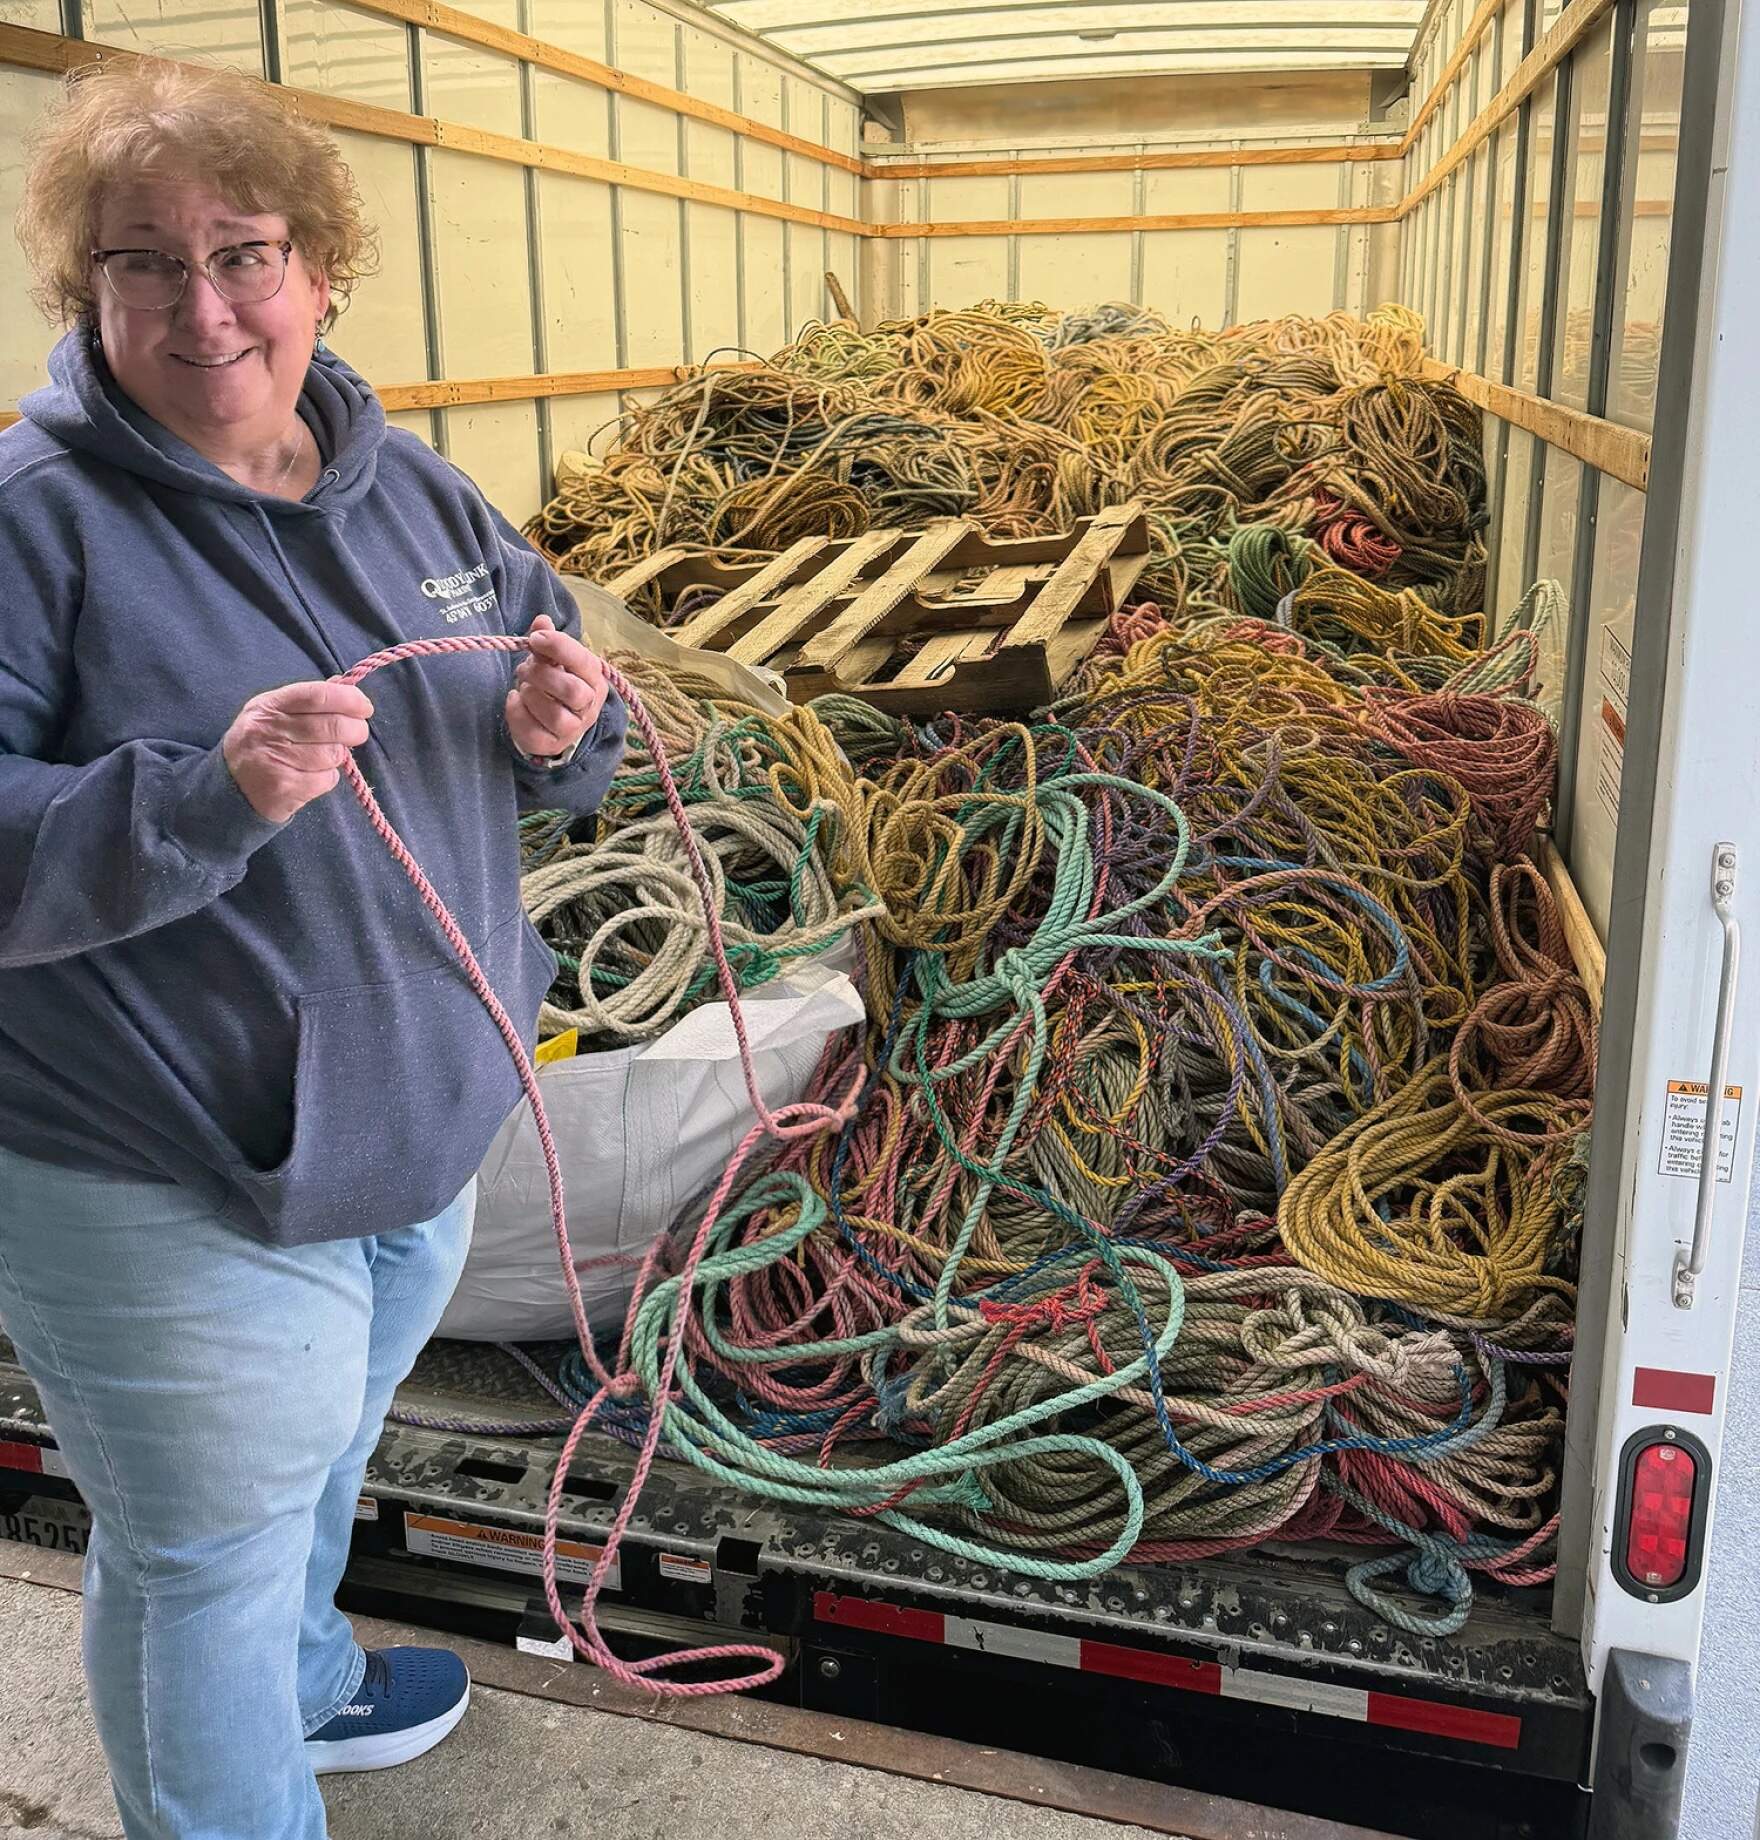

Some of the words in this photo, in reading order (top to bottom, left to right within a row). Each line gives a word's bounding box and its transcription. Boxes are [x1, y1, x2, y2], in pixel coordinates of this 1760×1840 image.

[3, 1514, 84, 1554] 8525
[489, 1530, 546, 1550] WARNING
[337, 1704, 375, 1717] OOKS
